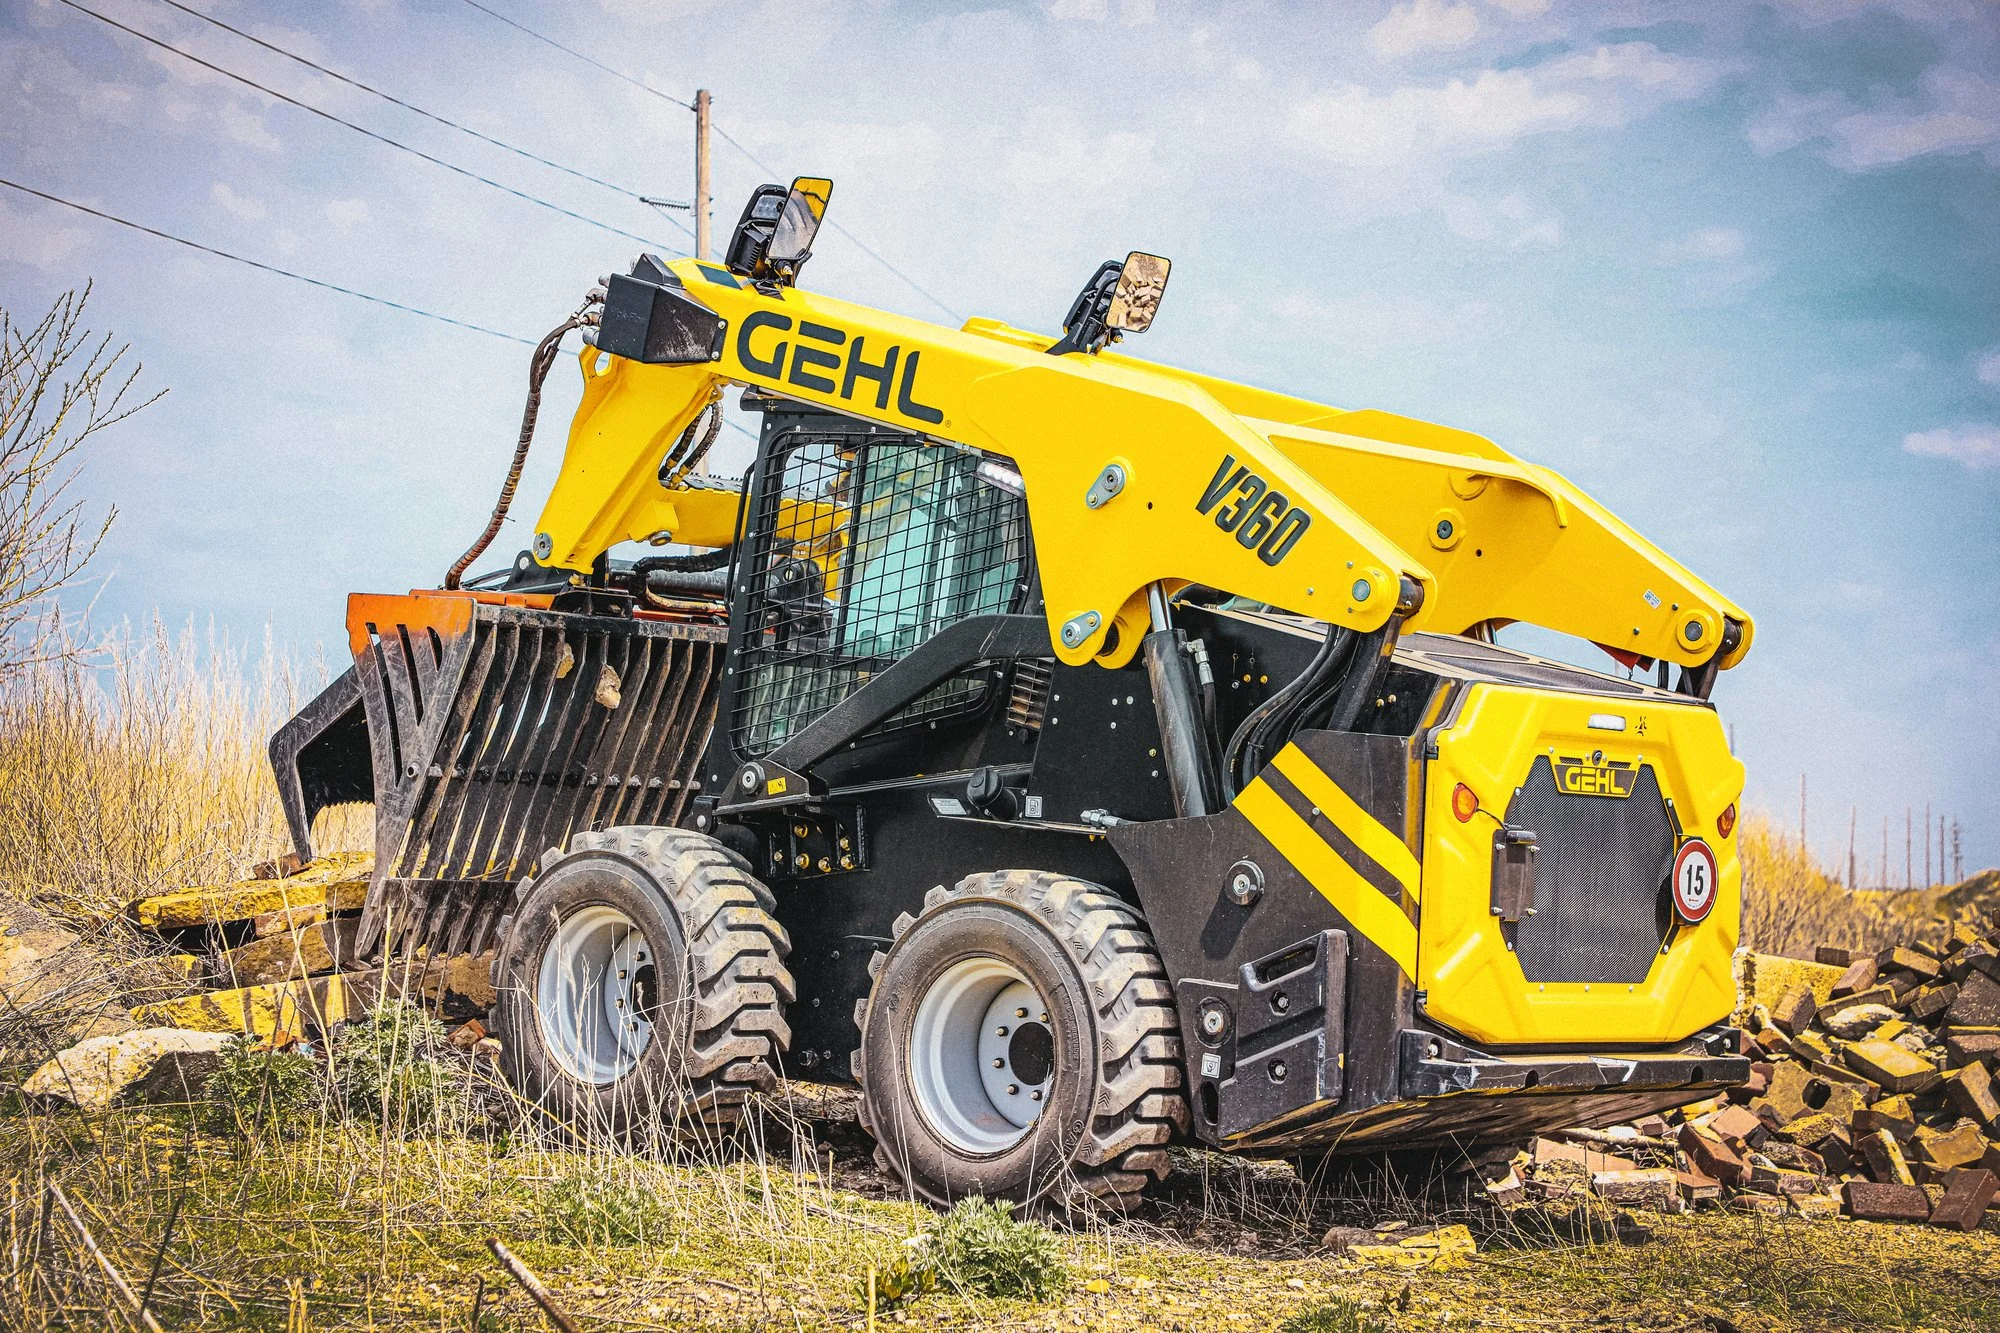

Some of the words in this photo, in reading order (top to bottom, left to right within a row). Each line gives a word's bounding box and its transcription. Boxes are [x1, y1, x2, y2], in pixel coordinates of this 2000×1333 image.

[737, 311, 943, 424] GEHL
[1195, 454, 1312, 567] V360
[1565, 766, 1624, 794] GEHL
[1686, 864, 1704, 895] 15
